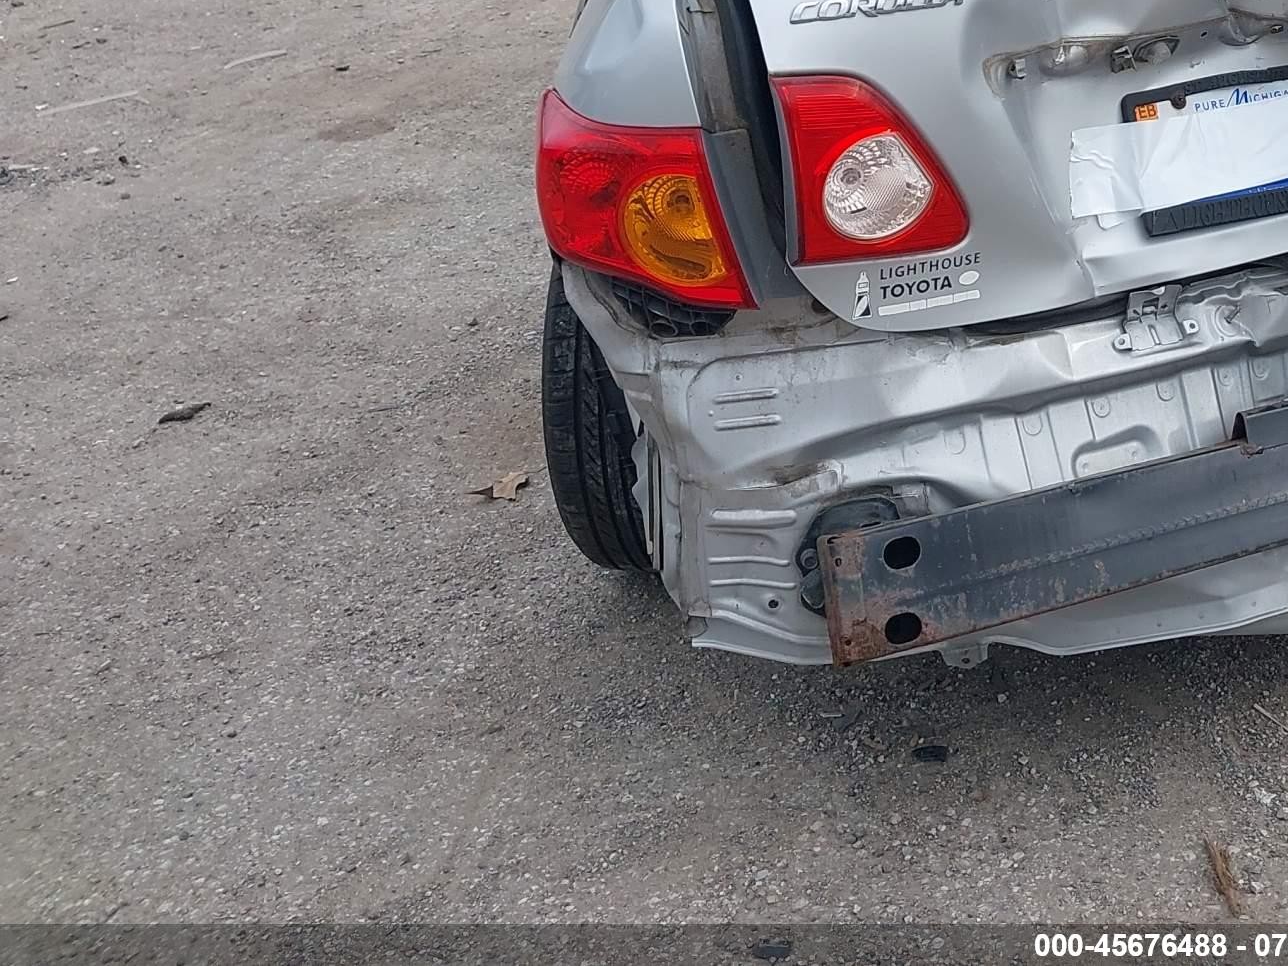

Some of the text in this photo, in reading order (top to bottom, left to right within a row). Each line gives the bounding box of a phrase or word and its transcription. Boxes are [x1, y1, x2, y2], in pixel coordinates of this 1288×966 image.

[1194, 99, 1226, 112] PURE
[880, 252, 981, 280] LIGHTHOUSE
[880, 275, 952, 299] TOYOTA
